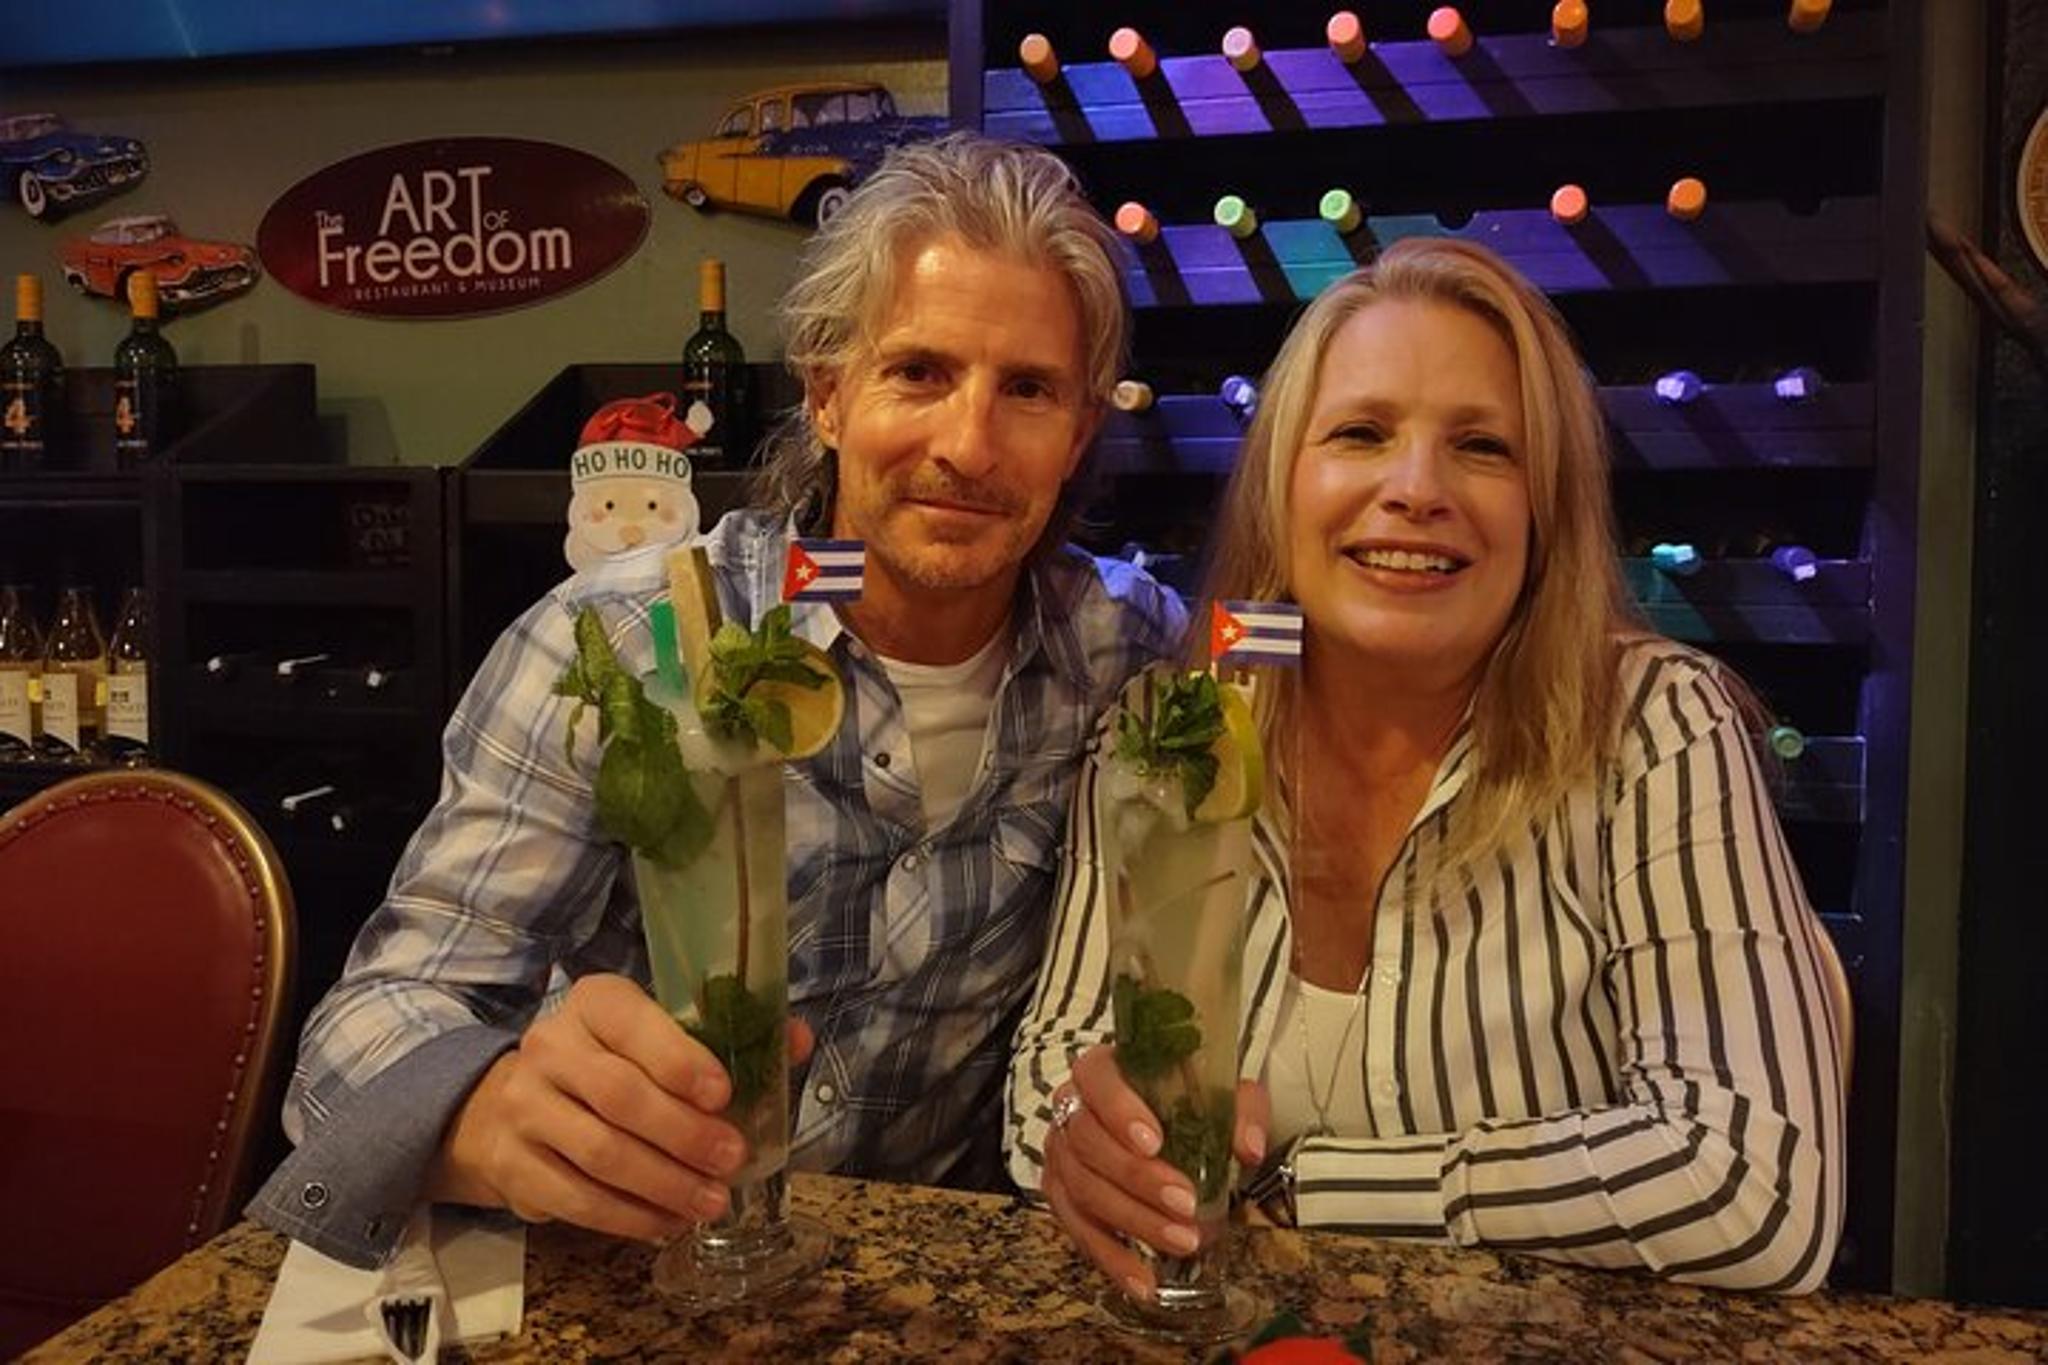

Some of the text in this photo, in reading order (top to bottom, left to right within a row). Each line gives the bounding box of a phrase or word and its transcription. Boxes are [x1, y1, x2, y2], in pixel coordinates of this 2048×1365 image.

[378, 166, 509, 237] ART OF
[315, 208, 344, 230] The
[318, 225, 572, 288] Freedom
[355, 277, 541, 300] RESTAURANT & MUSEUM
[574, 447, 690, 479] HO HO HO
